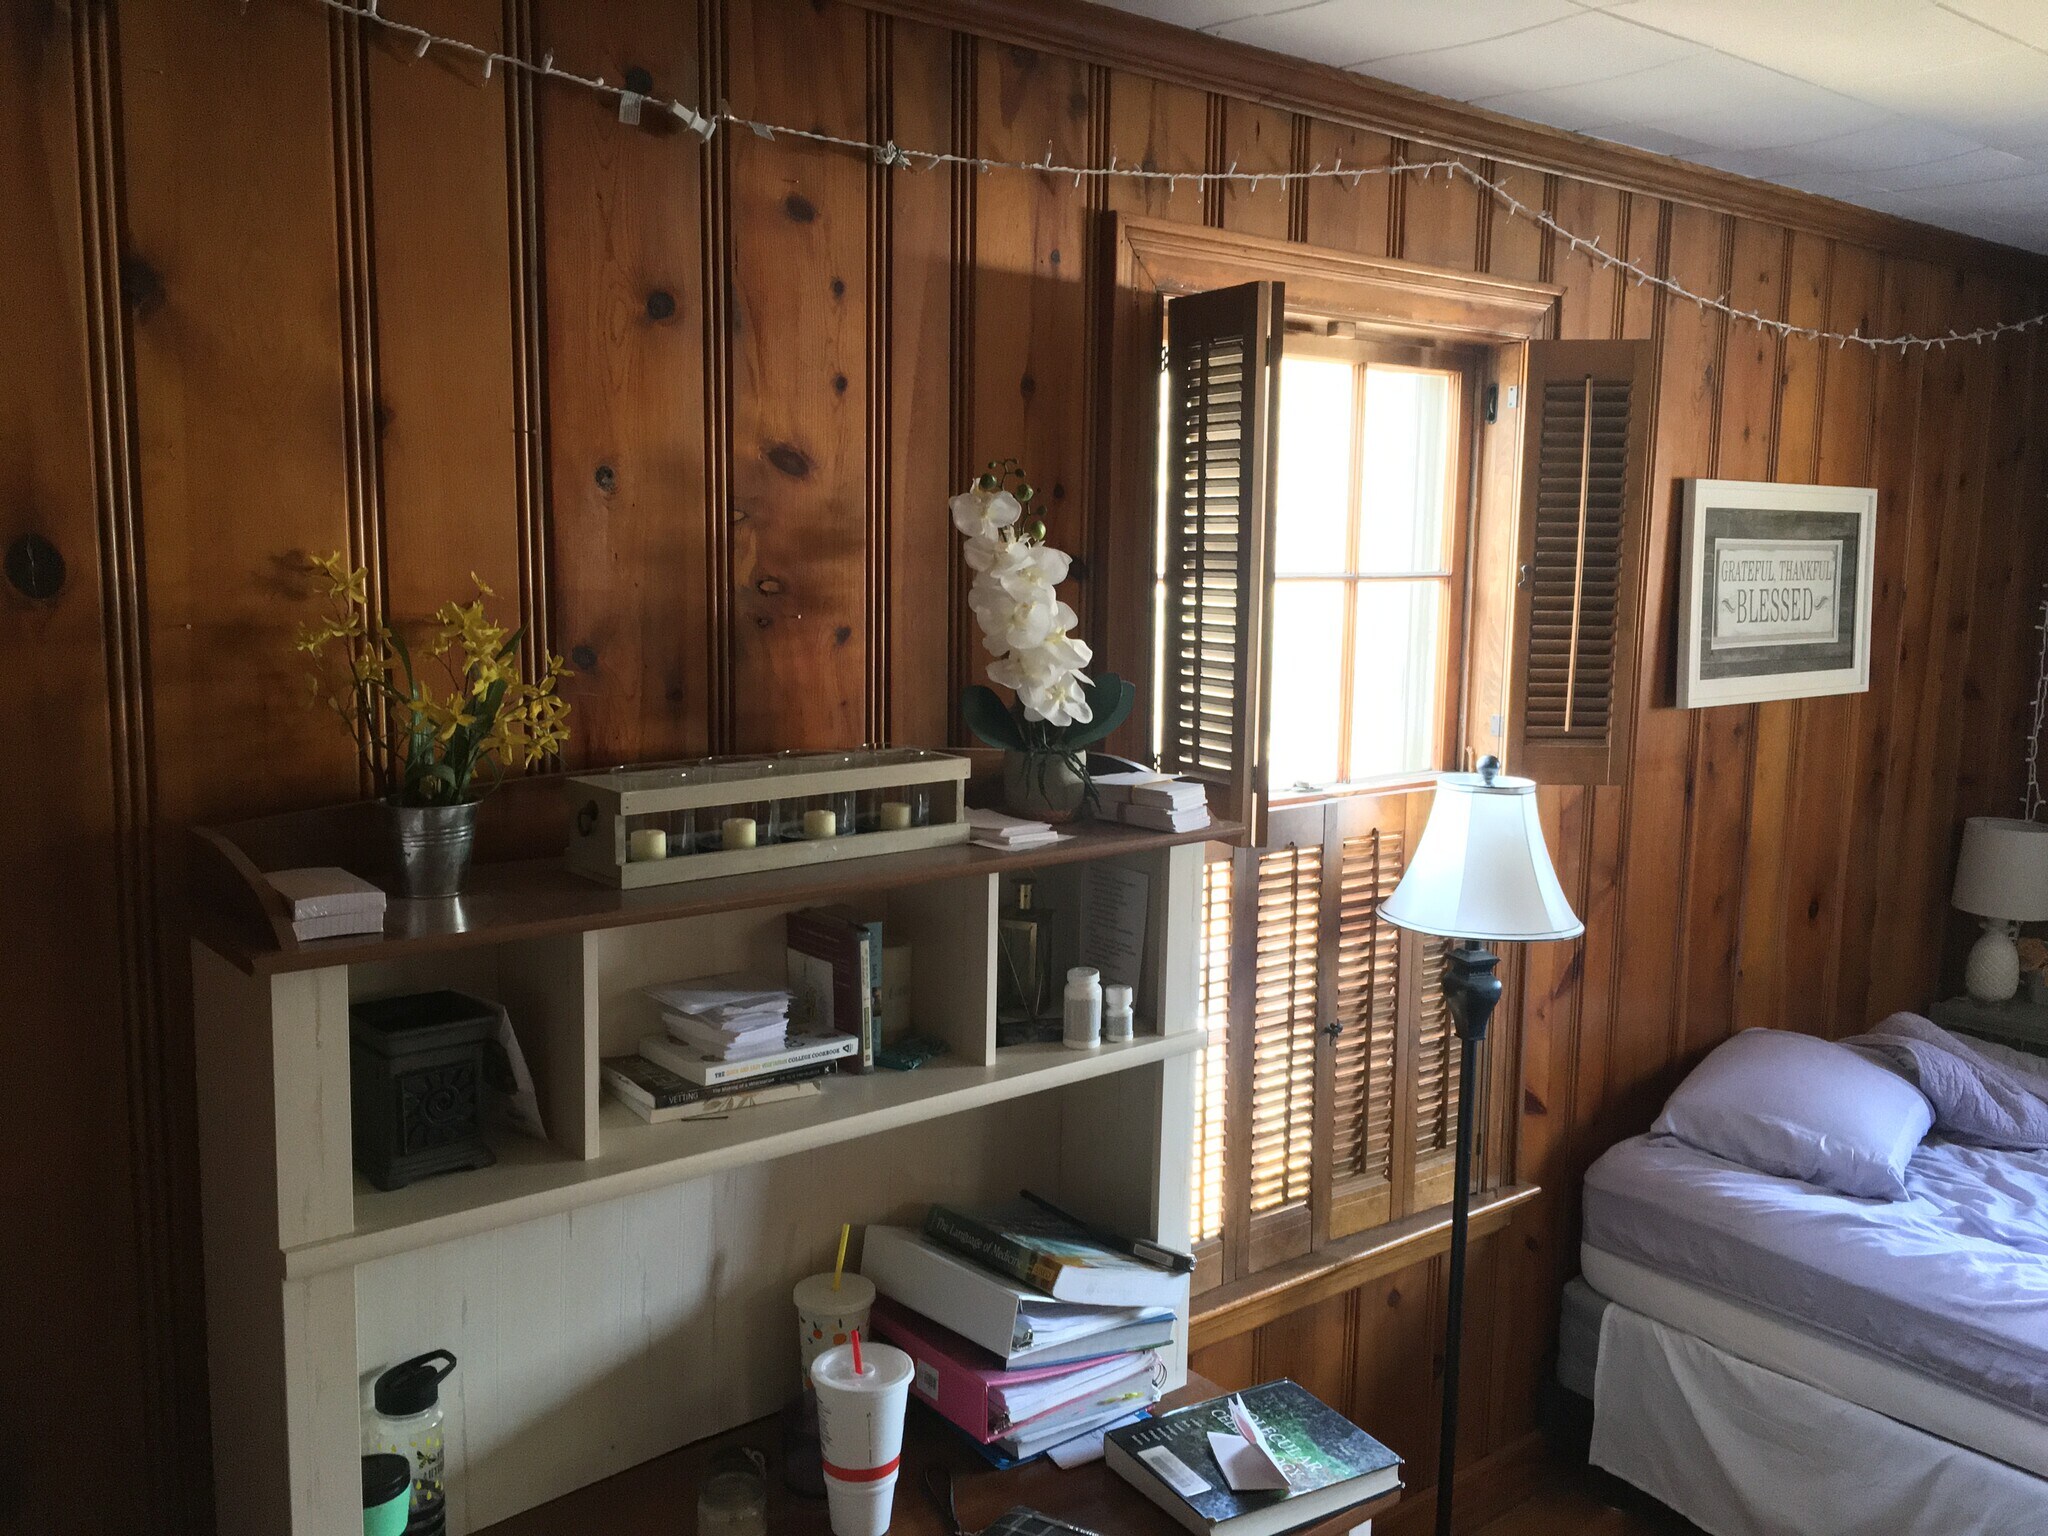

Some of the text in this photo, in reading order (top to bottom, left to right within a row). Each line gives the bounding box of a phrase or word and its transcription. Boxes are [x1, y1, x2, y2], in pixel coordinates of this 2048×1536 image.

[1779, 560, 1832, 581] THANKFUL
[1736, 588, 1813, 624] BLESSED
[787, 1053, 812, 1064] COLLEGE
[811, 1048, 840, 1059] COOKBOOK
[668, 1091, 699, 1105] VETTING
[935, 1216, 951, 1234] The
[949, 1223, 983, 1250] Language
[982, 1240, 992, 1254] of
[1248, 1409, 1323, 1473] OLECULAR
